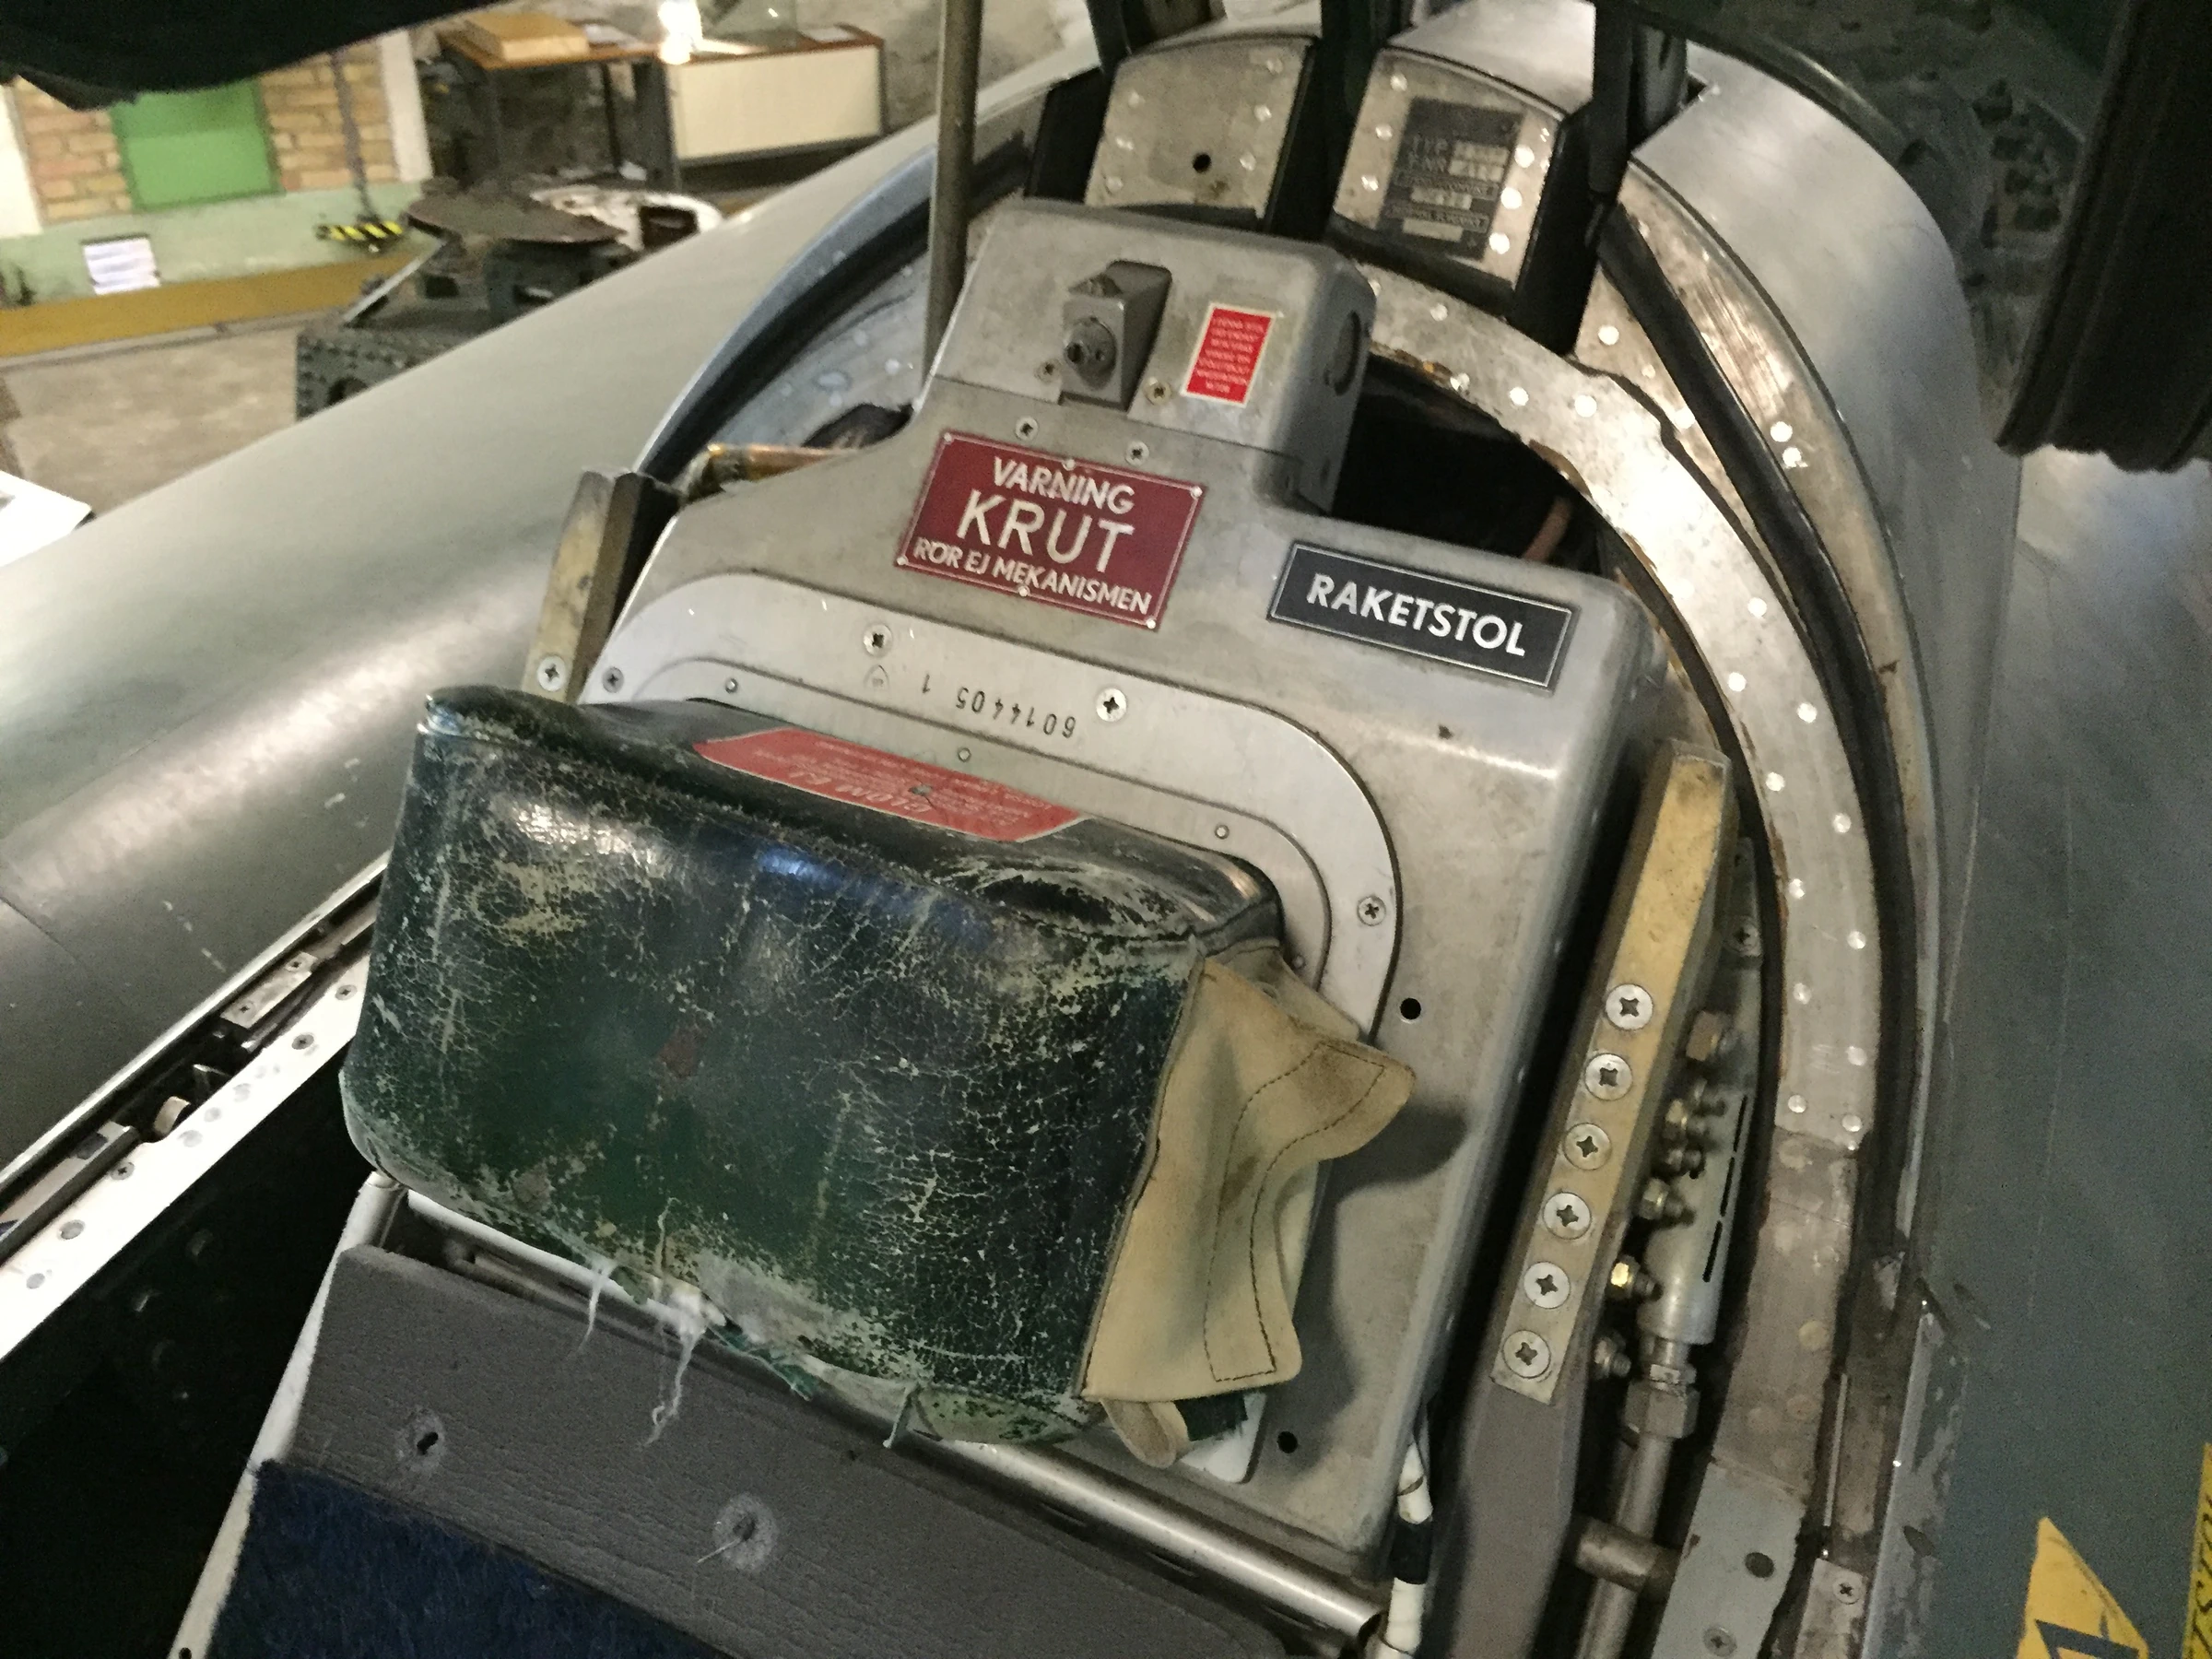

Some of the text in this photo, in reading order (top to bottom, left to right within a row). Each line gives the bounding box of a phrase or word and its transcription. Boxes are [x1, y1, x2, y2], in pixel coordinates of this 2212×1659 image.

[993, 455, 1135, 515] VARNING
[955, 488, 1135, 573] KRUT
[964, 551, 991, 574] EJ
[992, 556, 1153, 616] MEKANISMEN
[1306, 572, 1526, 657] RAKETSTOL
[955, 686, 1077, 739] 6014405
